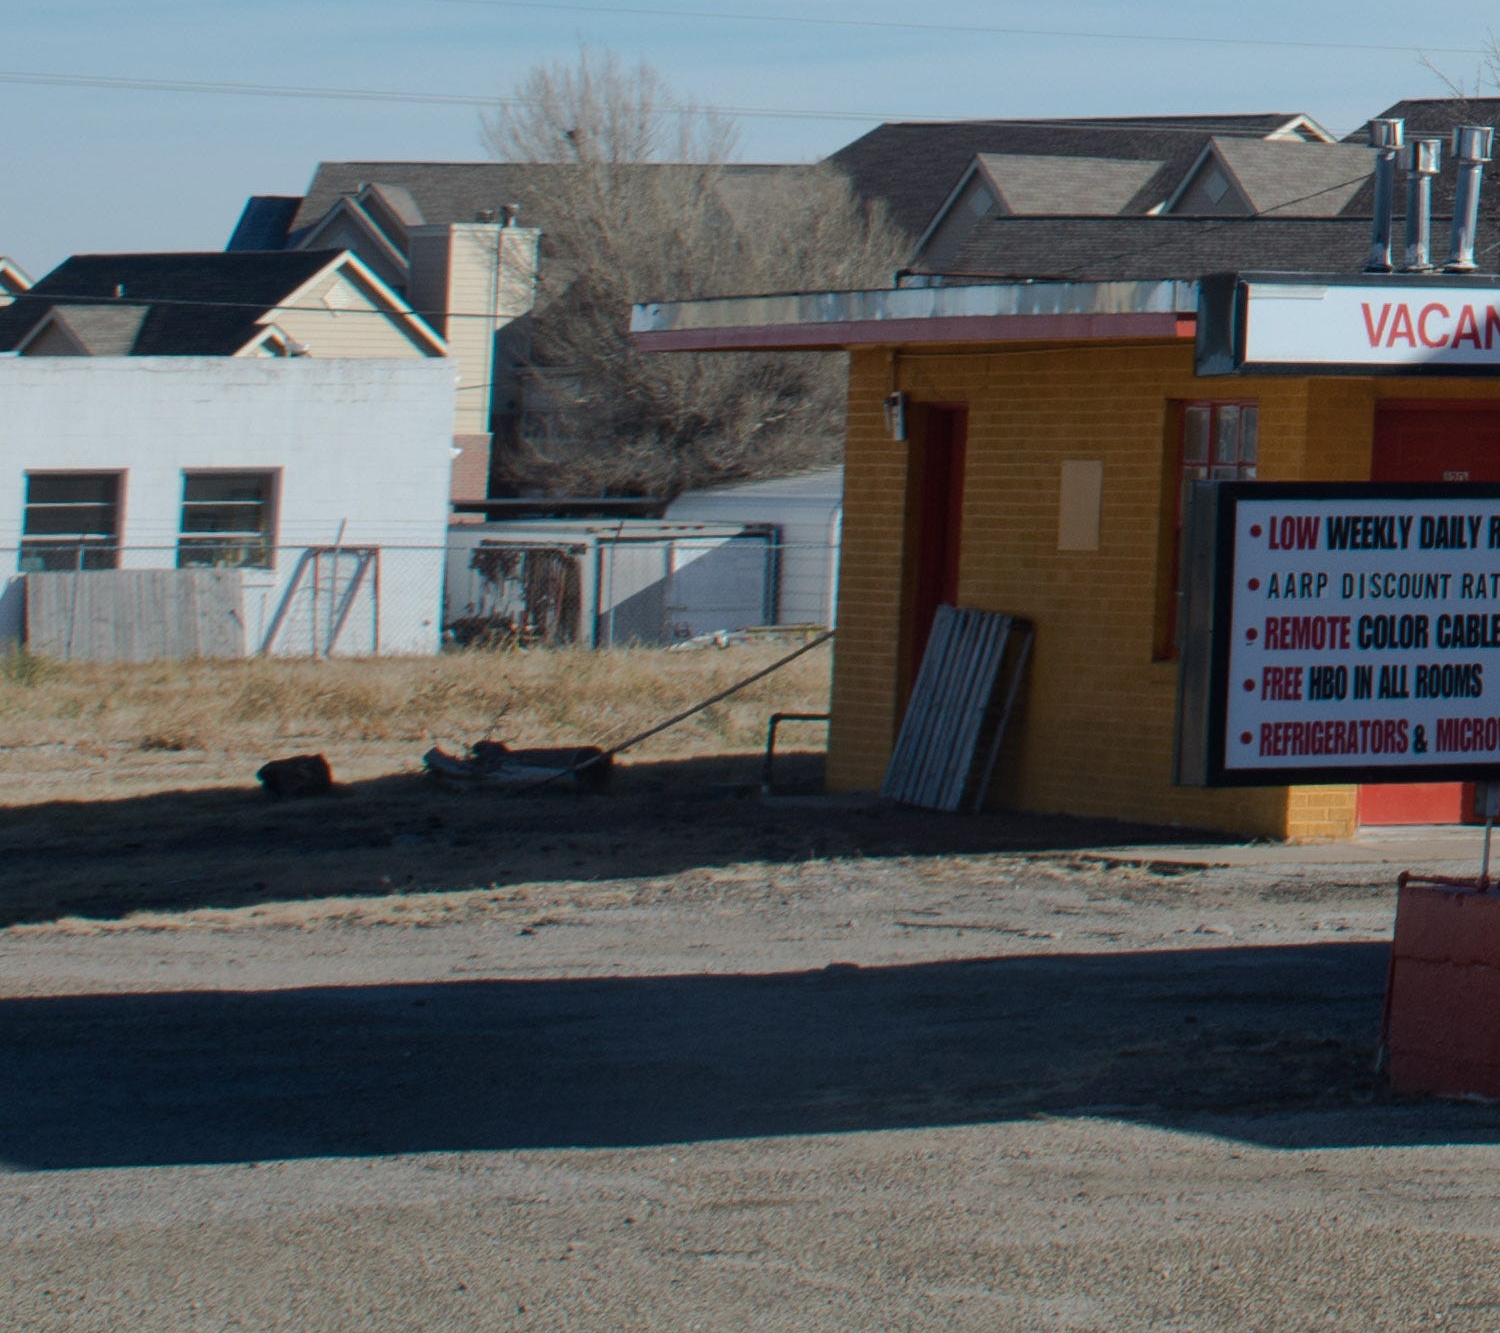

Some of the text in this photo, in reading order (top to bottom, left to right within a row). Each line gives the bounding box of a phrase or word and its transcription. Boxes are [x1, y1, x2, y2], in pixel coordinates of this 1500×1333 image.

[1268, 515, 1320, 550] LOW
[1326, 515, 1413, 550] WEEKLY
[1418, 515, 1482, 550] DAILY
[1268, 572, 1329, 599] AARP
[1342, 572, 1452, 600] DISCOUNT
[1264, 615, 1351, 650] REMOTE
[1356, 614, 1429, 649] COLOR
[1261, 663, 1483, 700] FREE HBO IN ALL ROOMS
[1259, 719, 1409, 757] REFRIGERATORS
[1412, 724, 1428, 753] &
